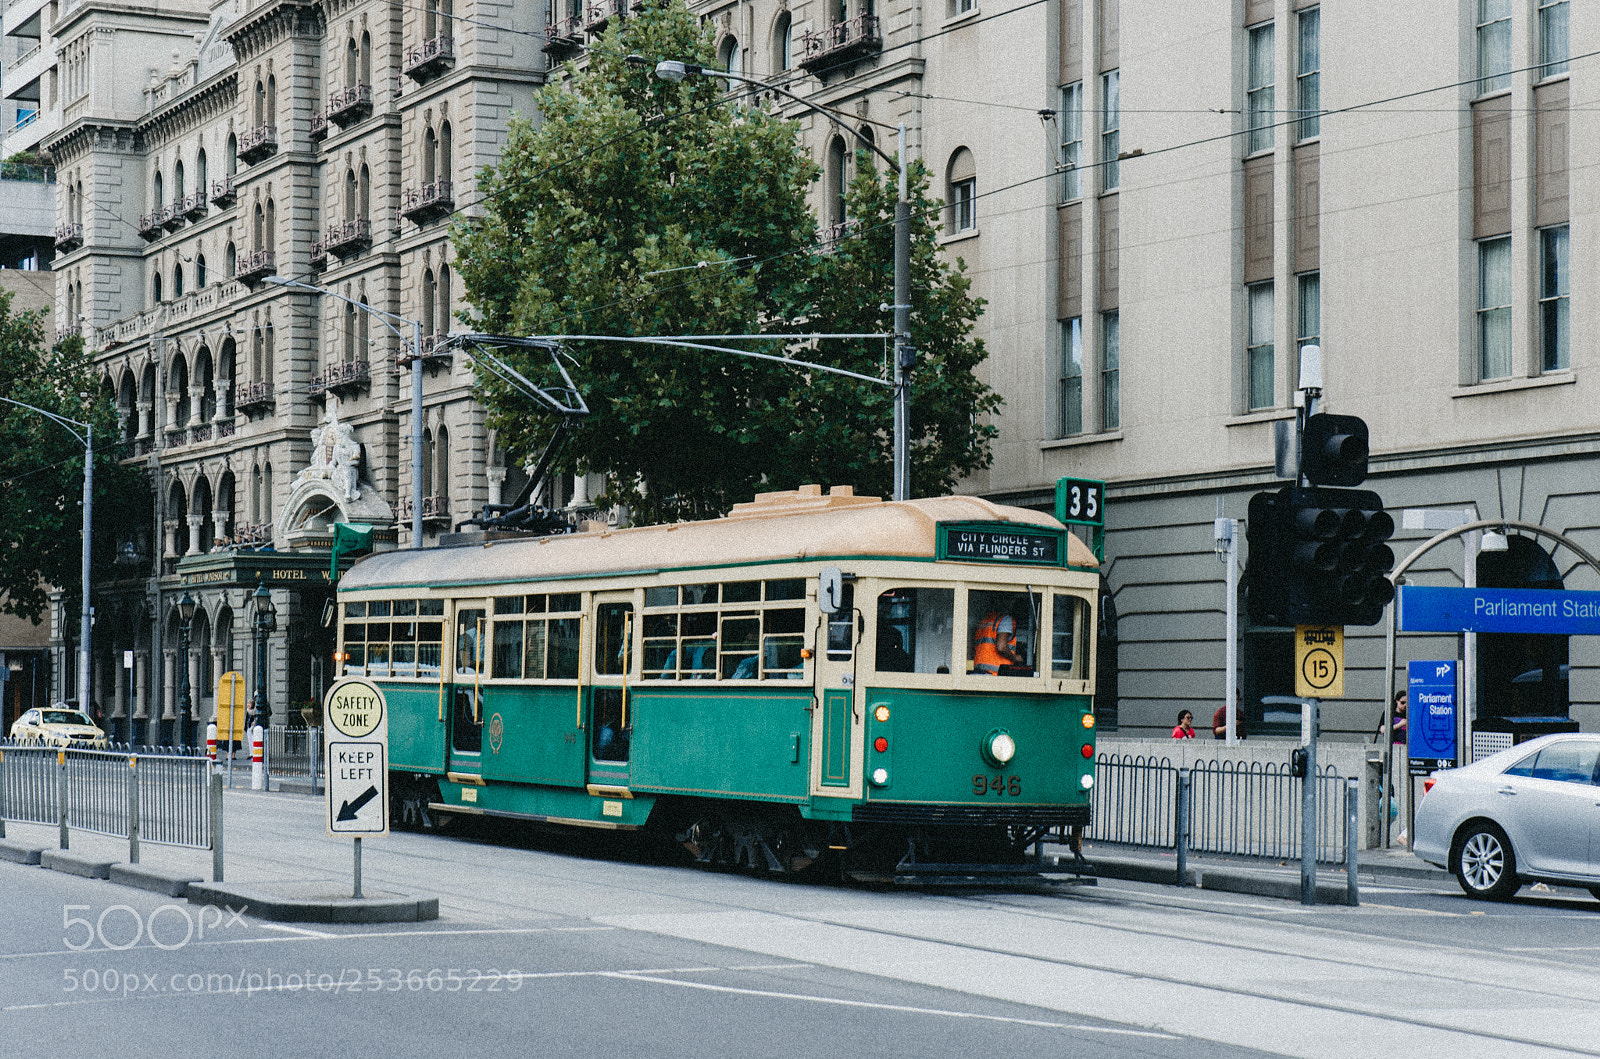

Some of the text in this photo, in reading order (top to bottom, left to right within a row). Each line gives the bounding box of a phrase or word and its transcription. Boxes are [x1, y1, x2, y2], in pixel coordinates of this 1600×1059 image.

[1070, 486, 1097, 517] 35
[961, 532, 985, 542] CITY
[991, 534, 1029, 545] CIRCLE
[957, 542, 1045, 557] VIA FLINDERS ST
[272, 569, 307, 580] HOTEL
[1474, 597, 1600, 618] Parliament Stati
[1312, 660, 1329, 679] 15
[336, 696, 375, 710] SAFETY
[1418, 693, 1453, 704] Parliament
[1429, 704, 1453, 716] Station
[342, 713, 369, 727] ZONE
[339, 751, 374, 764] KEEP
[340, 768, 374, 780] LEFT
[972, 774, 1021, 796] 946
